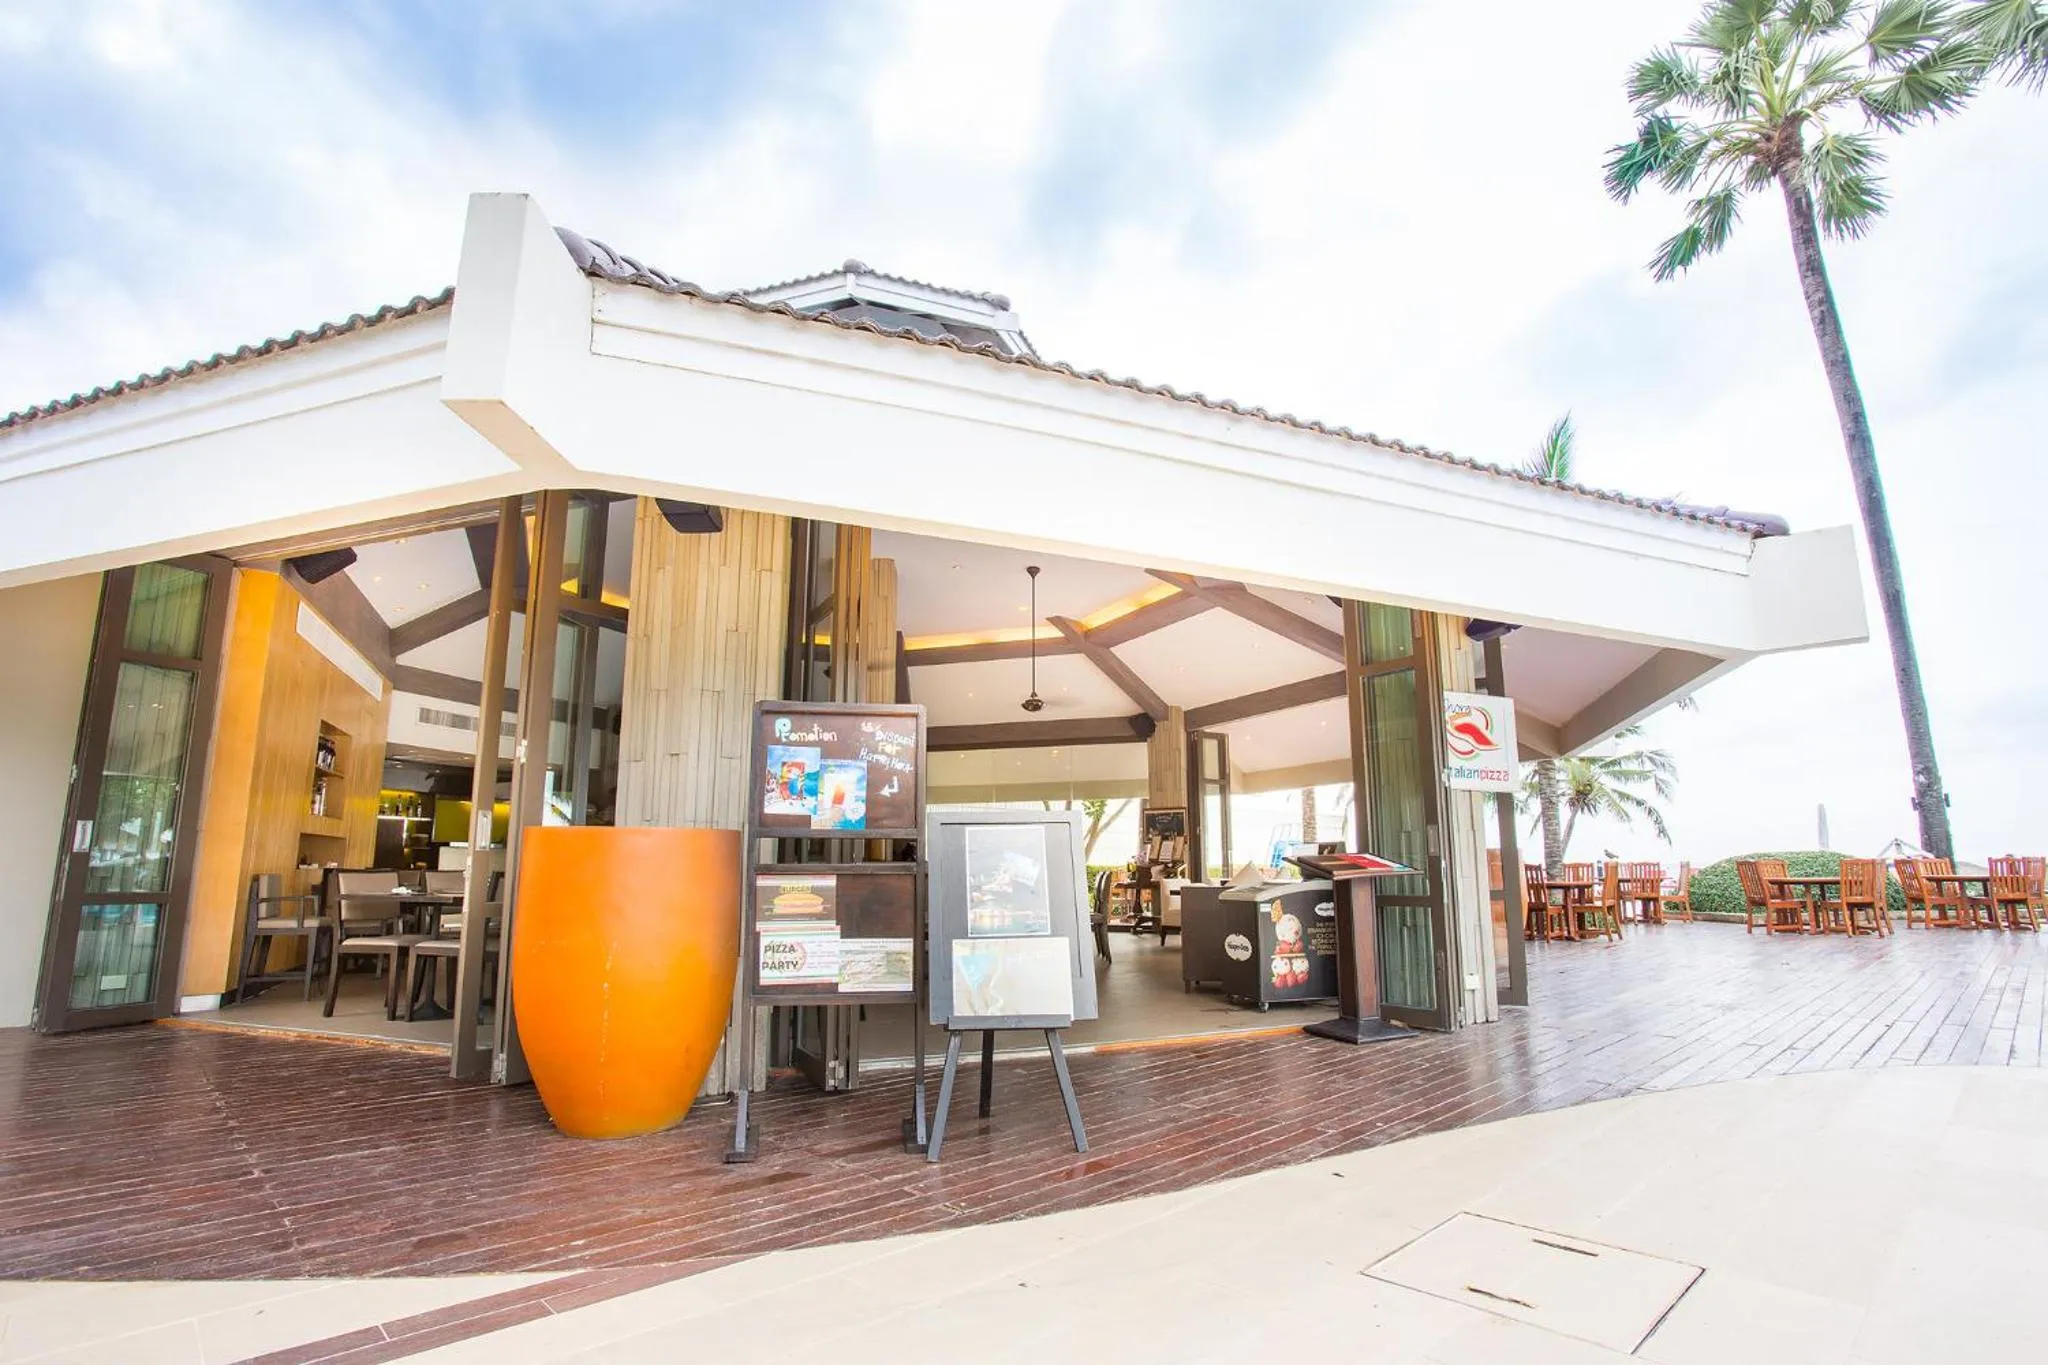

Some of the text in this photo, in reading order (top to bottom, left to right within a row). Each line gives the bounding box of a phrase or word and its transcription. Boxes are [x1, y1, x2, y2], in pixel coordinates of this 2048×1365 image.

[775, 717, 838, 742] Promotion
[764, 943, 797, 954] PIZZA
[761, 960, 799, 971] PARTY
